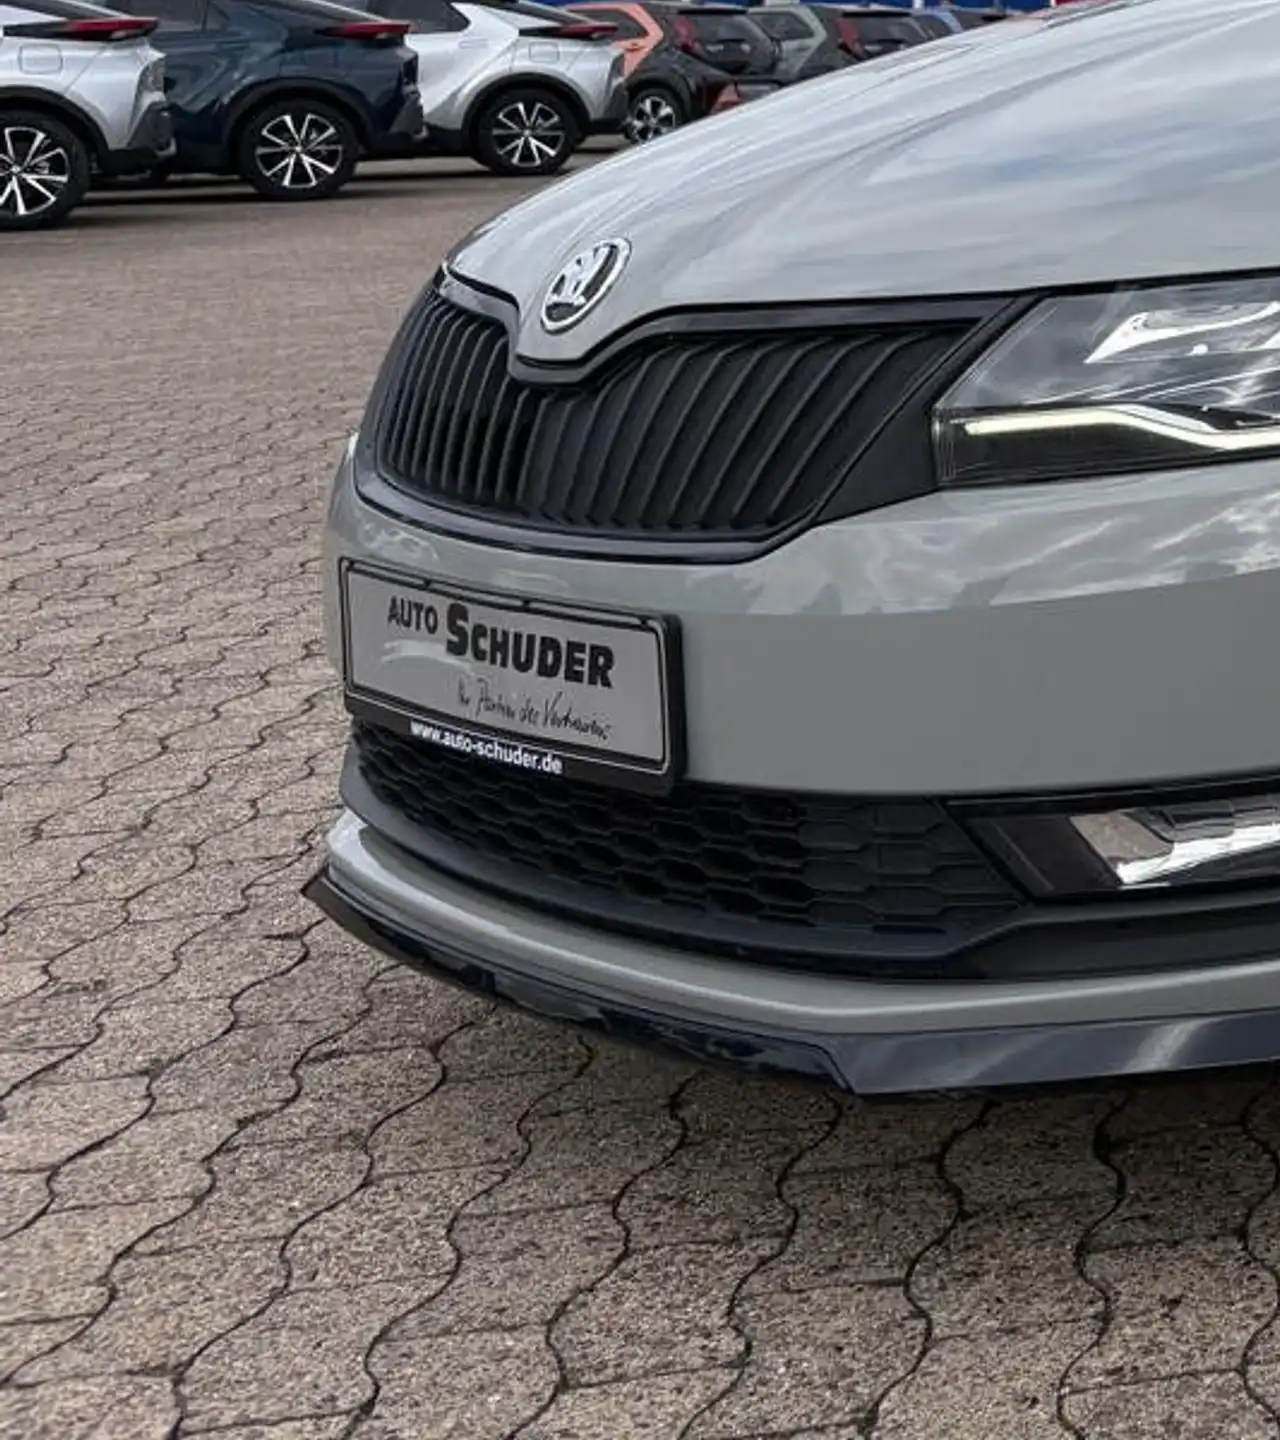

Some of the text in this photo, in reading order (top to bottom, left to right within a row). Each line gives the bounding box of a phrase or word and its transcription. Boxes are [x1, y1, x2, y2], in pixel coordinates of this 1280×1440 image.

[387, 595, 616, 689] AUTO SCHUDER
[410, 716, 564, 775] www.auto-schuder.de
